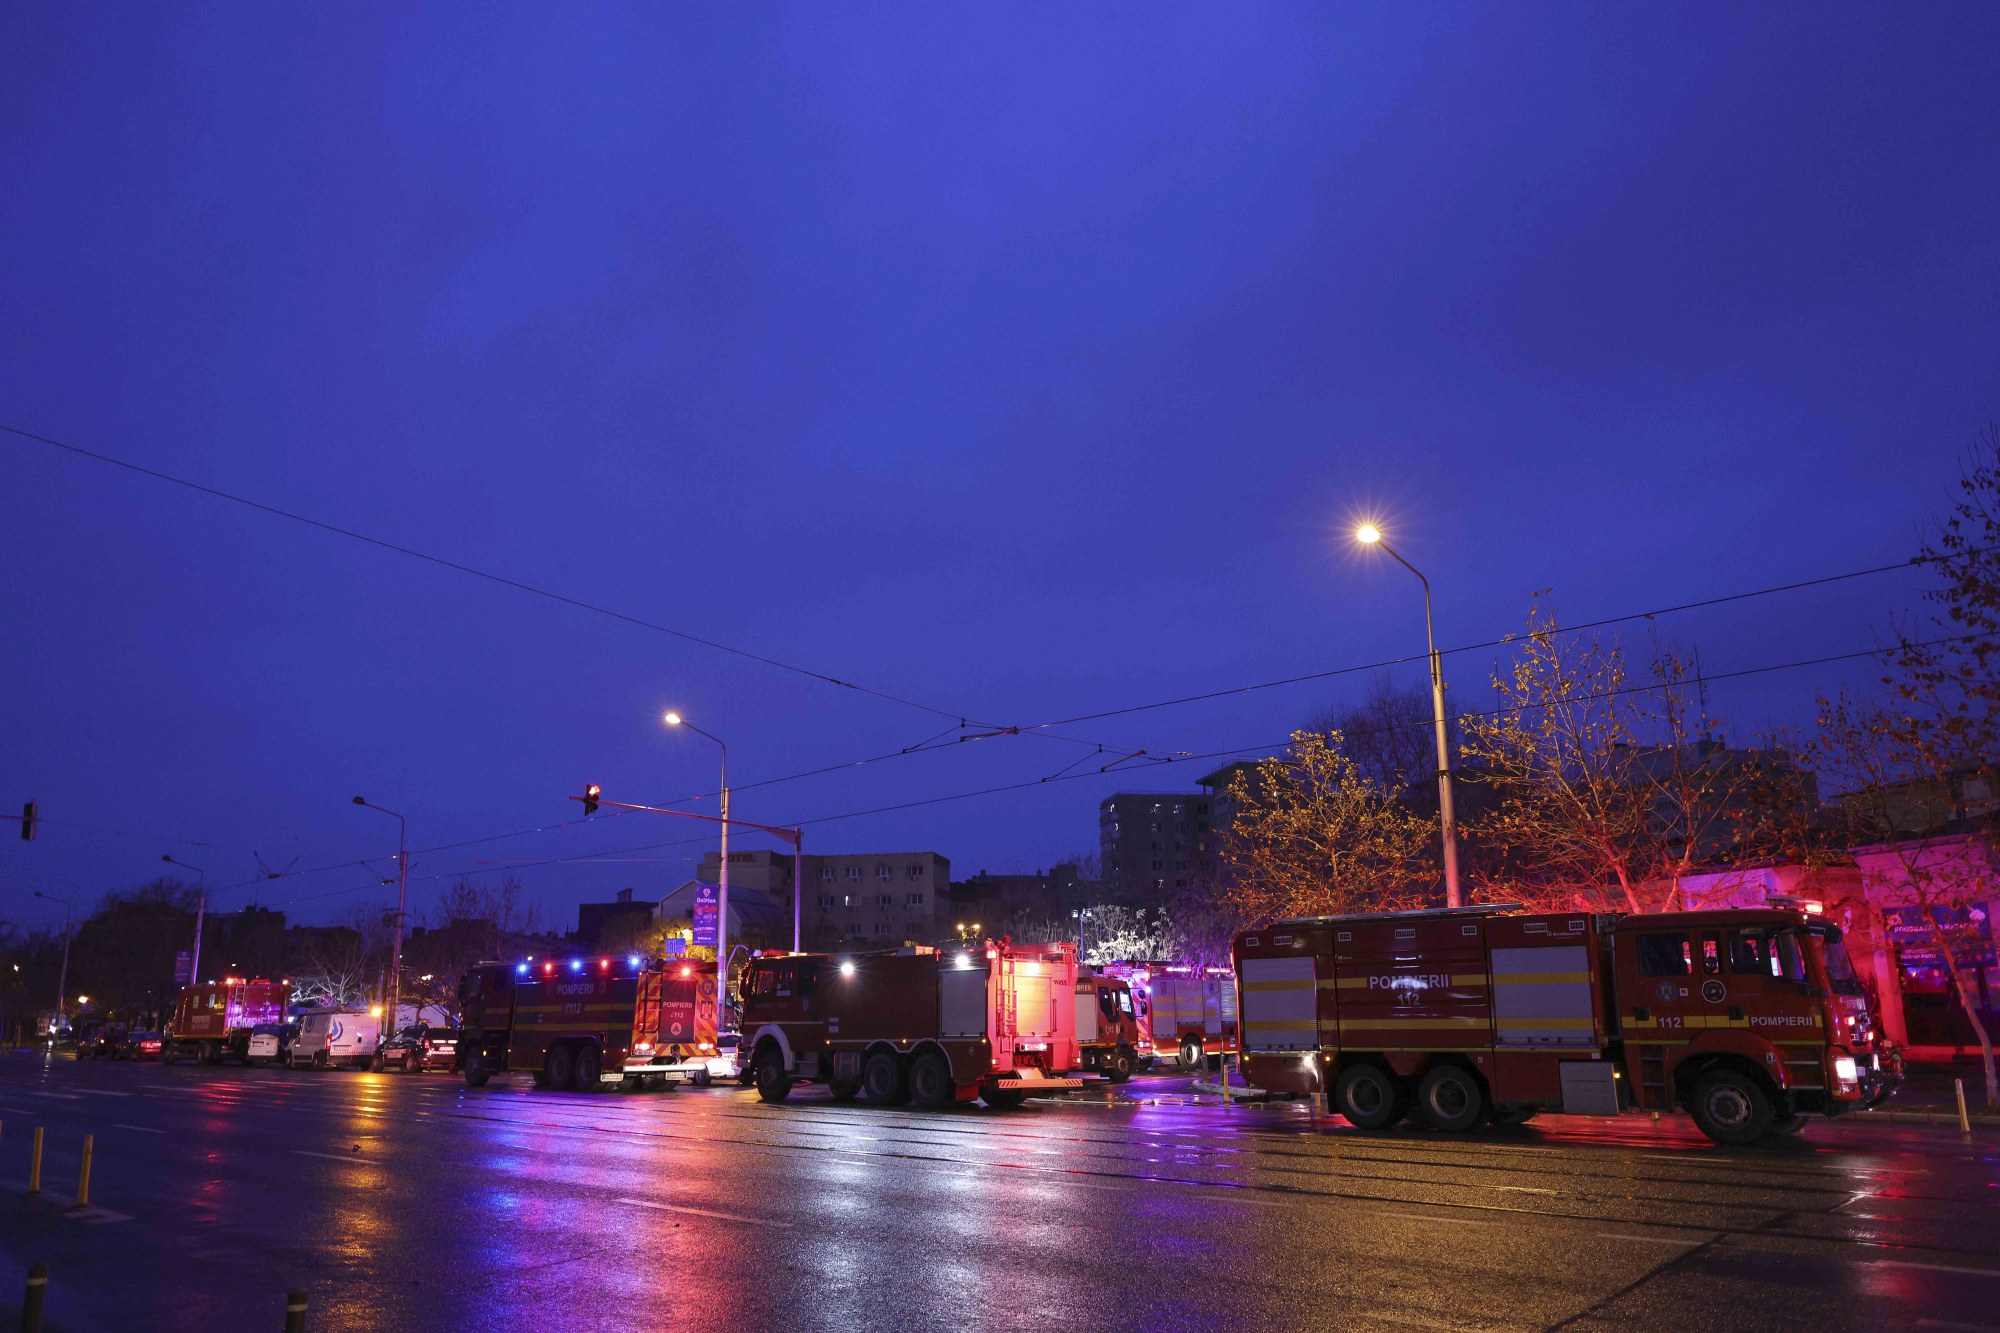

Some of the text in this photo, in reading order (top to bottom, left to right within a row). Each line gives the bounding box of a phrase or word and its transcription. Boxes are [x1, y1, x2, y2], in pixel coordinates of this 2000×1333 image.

[557, 983, 594, 996] POMPIERII
[1397, 994, 1421, 1005] 112
[1658, 1016, 1813, 1029] 112 POMPIERII
